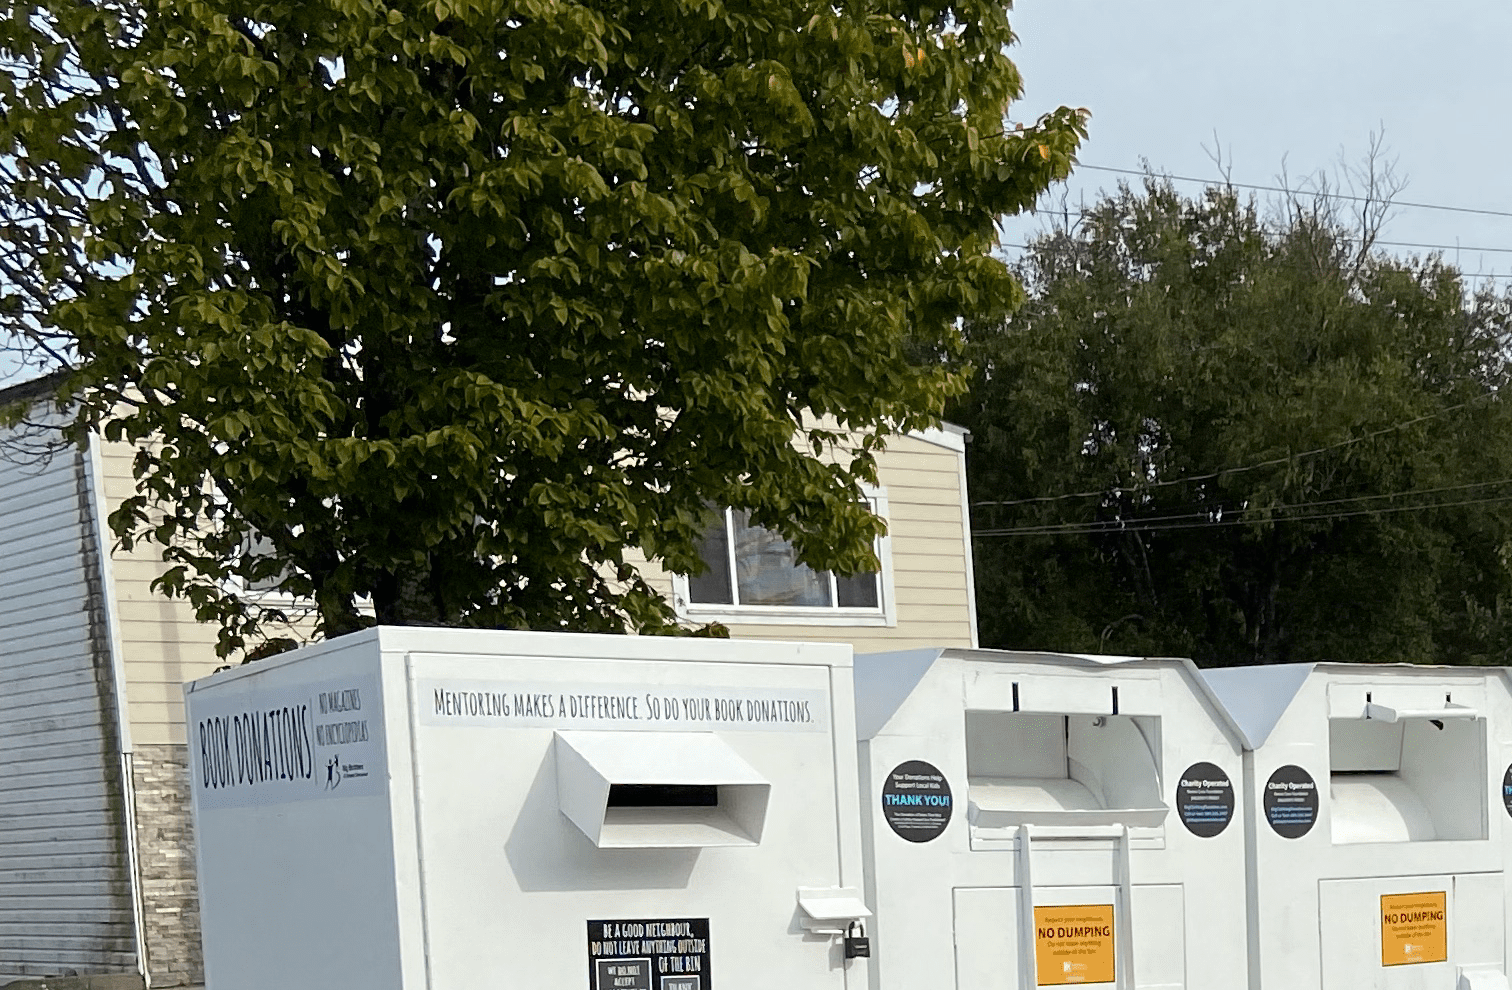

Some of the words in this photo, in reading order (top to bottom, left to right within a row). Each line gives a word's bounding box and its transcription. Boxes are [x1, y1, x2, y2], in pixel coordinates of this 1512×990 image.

[319, 693, 327, 714] NO
[328, 688, 361, 713] MAGAZINES
[434, 688, 510, 717] MENTORING
[514, 694, 554, 718] MAKES
[559, 695, 567, 718] A
[569, 695, 642, 720] DIFFERENCE.
[646, 694, 660, 720] SO
[664, 697, 679, 720] DO
[682, 698, 711, 721] YOUR
[715, 698, 743, 722] BOOK
[747, 700, 814, 723] DONATIONS.
[200, 715, 235, 789] BOOK
[234, 704, 312, 785] DONATIONS
[885, 794, 923, 806] THANK
[924, 795, 950, 807] YOU!
[1385, 913, 1399, 924] NO
[1400, 911, 1443, 923] DUMPING
[603, 923, 613, 939] BE
[615, 923, 621, 938] A
[622, 923, 644, 938] GOOD
[1038, 927, 1055, 939] NO
[1058, 925, 1110, 938] DUMPING
[591, 941, 602, 956] DO
[603, 940, 618, 955] NOT
[618, 940, 640, 955] LEAVE
[641, 939, 677, 954] ANYTHING
[659, 956, 668, 973] OF
[670, 956, 684, 972] THE
[686, 955, 701, 972] BIN
